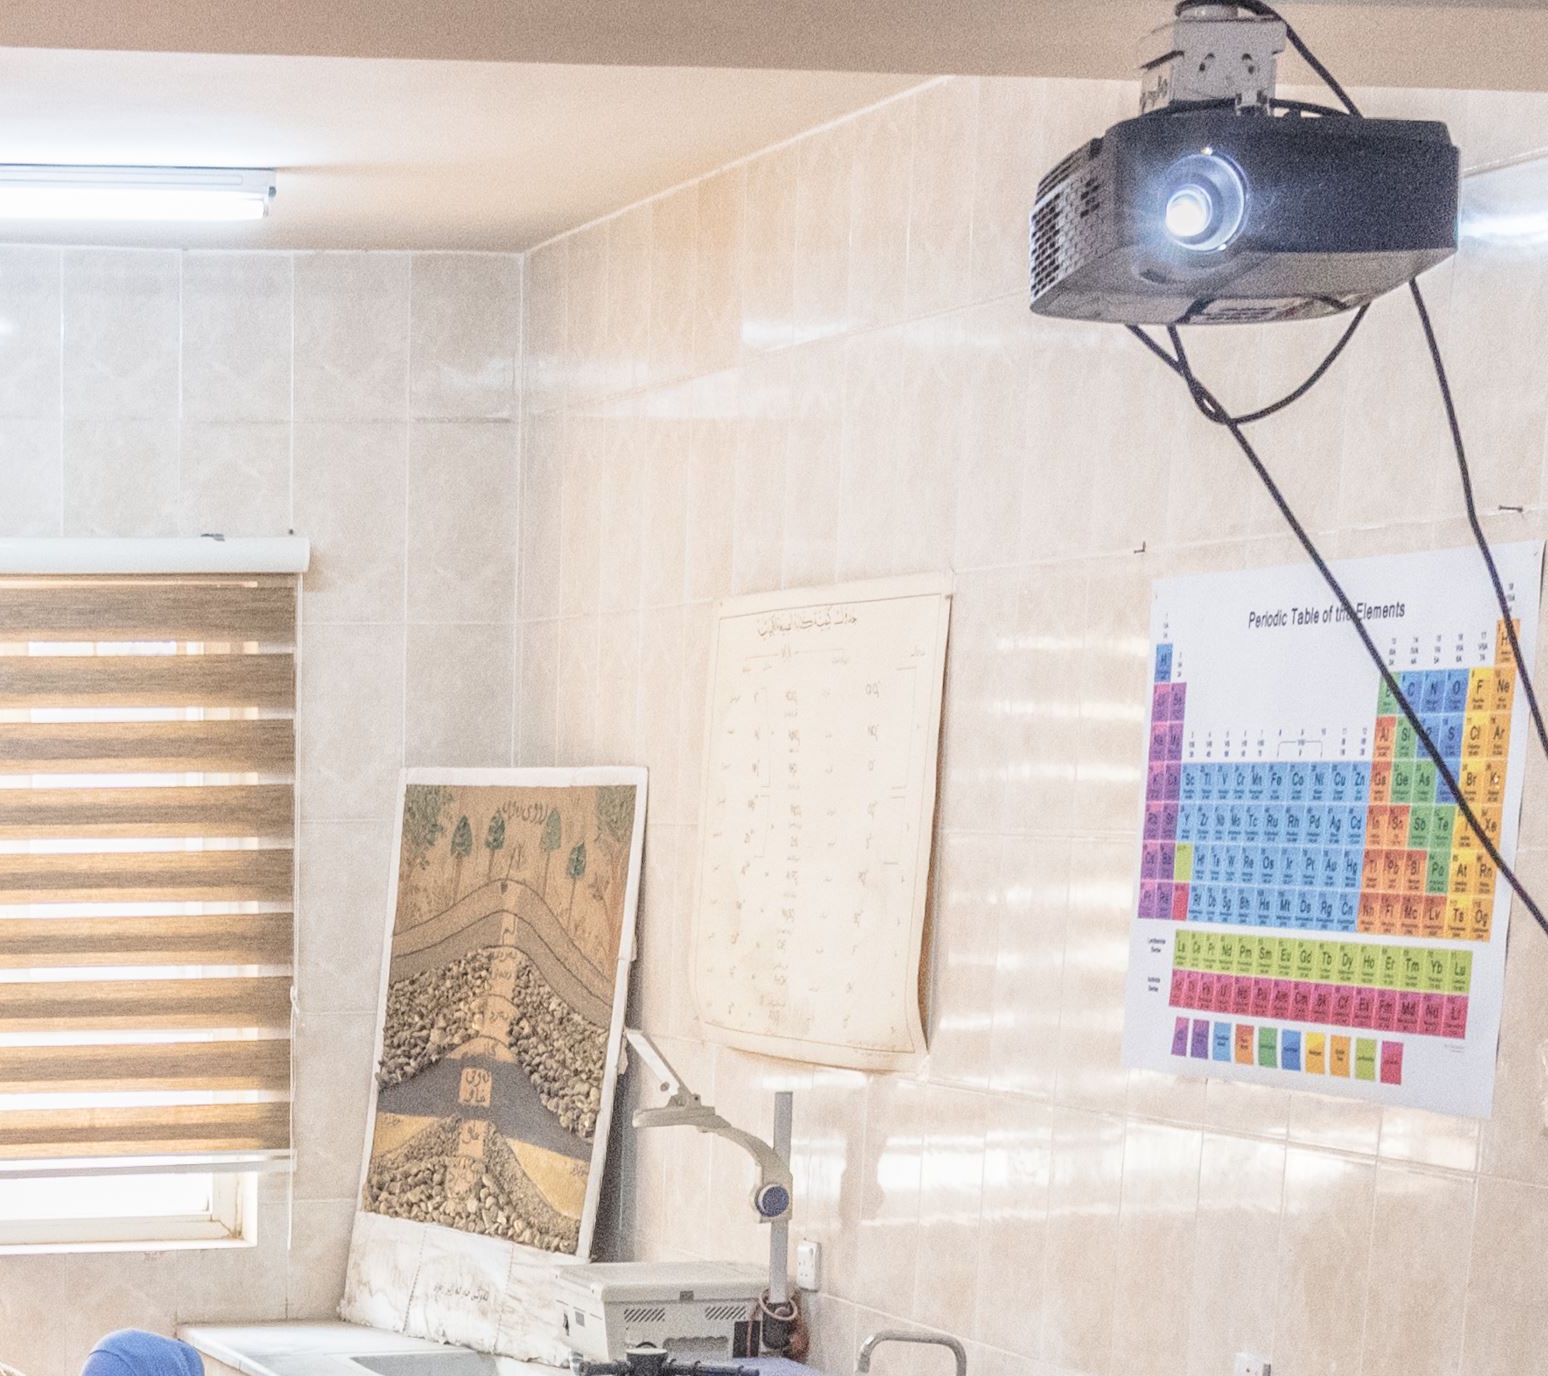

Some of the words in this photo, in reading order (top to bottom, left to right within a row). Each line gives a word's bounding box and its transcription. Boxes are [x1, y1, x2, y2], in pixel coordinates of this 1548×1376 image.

[1248, 610, 1288, 628] Periodic
[1291, 608, 1320, 625] Table
[1322, 605, 1334, 623] of
[1356, 602, 1406, 620] Elements
